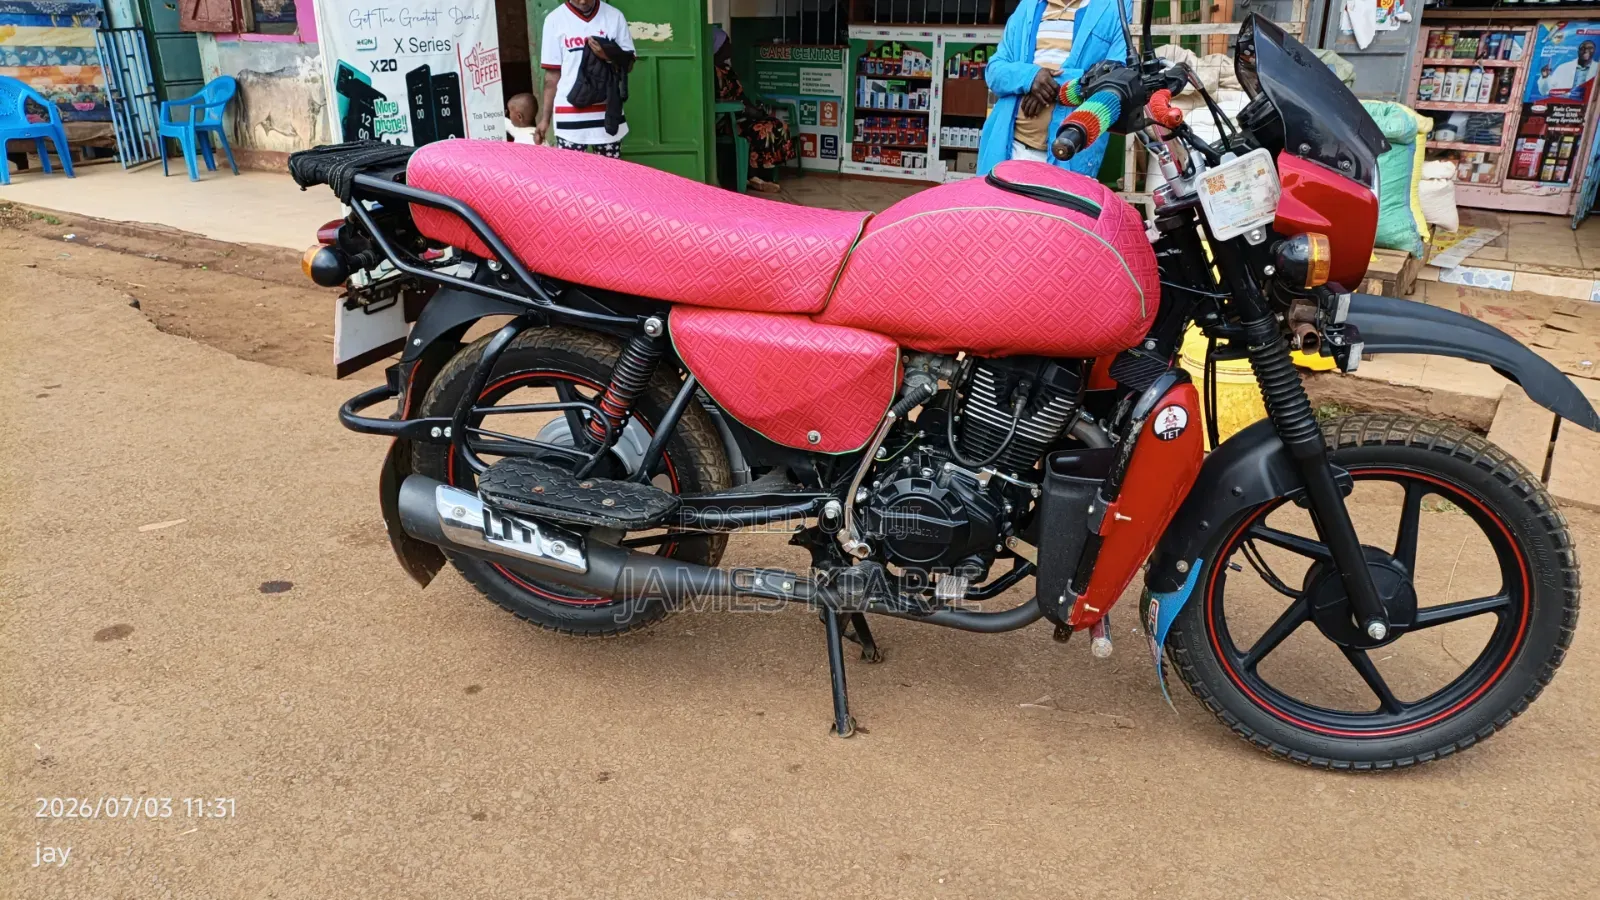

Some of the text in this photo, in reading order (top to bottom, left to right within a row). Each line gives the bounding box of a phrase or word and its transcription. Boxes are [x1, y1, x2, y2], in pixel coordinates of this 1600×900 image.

[348, 5, 480, 29] Get The Greatest Deals
[393, 36, 451, 54] X Series
[479, 53, 498, 66] SPECIAL
[760, 46, 840, 61] CARE CENTRE
[370, 59, 397, 73] X20
[474, 64, 499, 85] OFFER
[415, 94, 423, 105] 12
[440, 95, 449, 105] 12
[375, 100, 397, 115] More
[417, 108, 425, 119] 00
[441, 107, 450, 117] 00
[360, 113, 371, 127] 12
[473, 112, 482, 120] Toa
[375, 114, 407, 136] phone!!
[484, 124, 495, 132] Lipa
[358, 128, 369, 140] 00
[1162, 429, 1181, 440] TET
